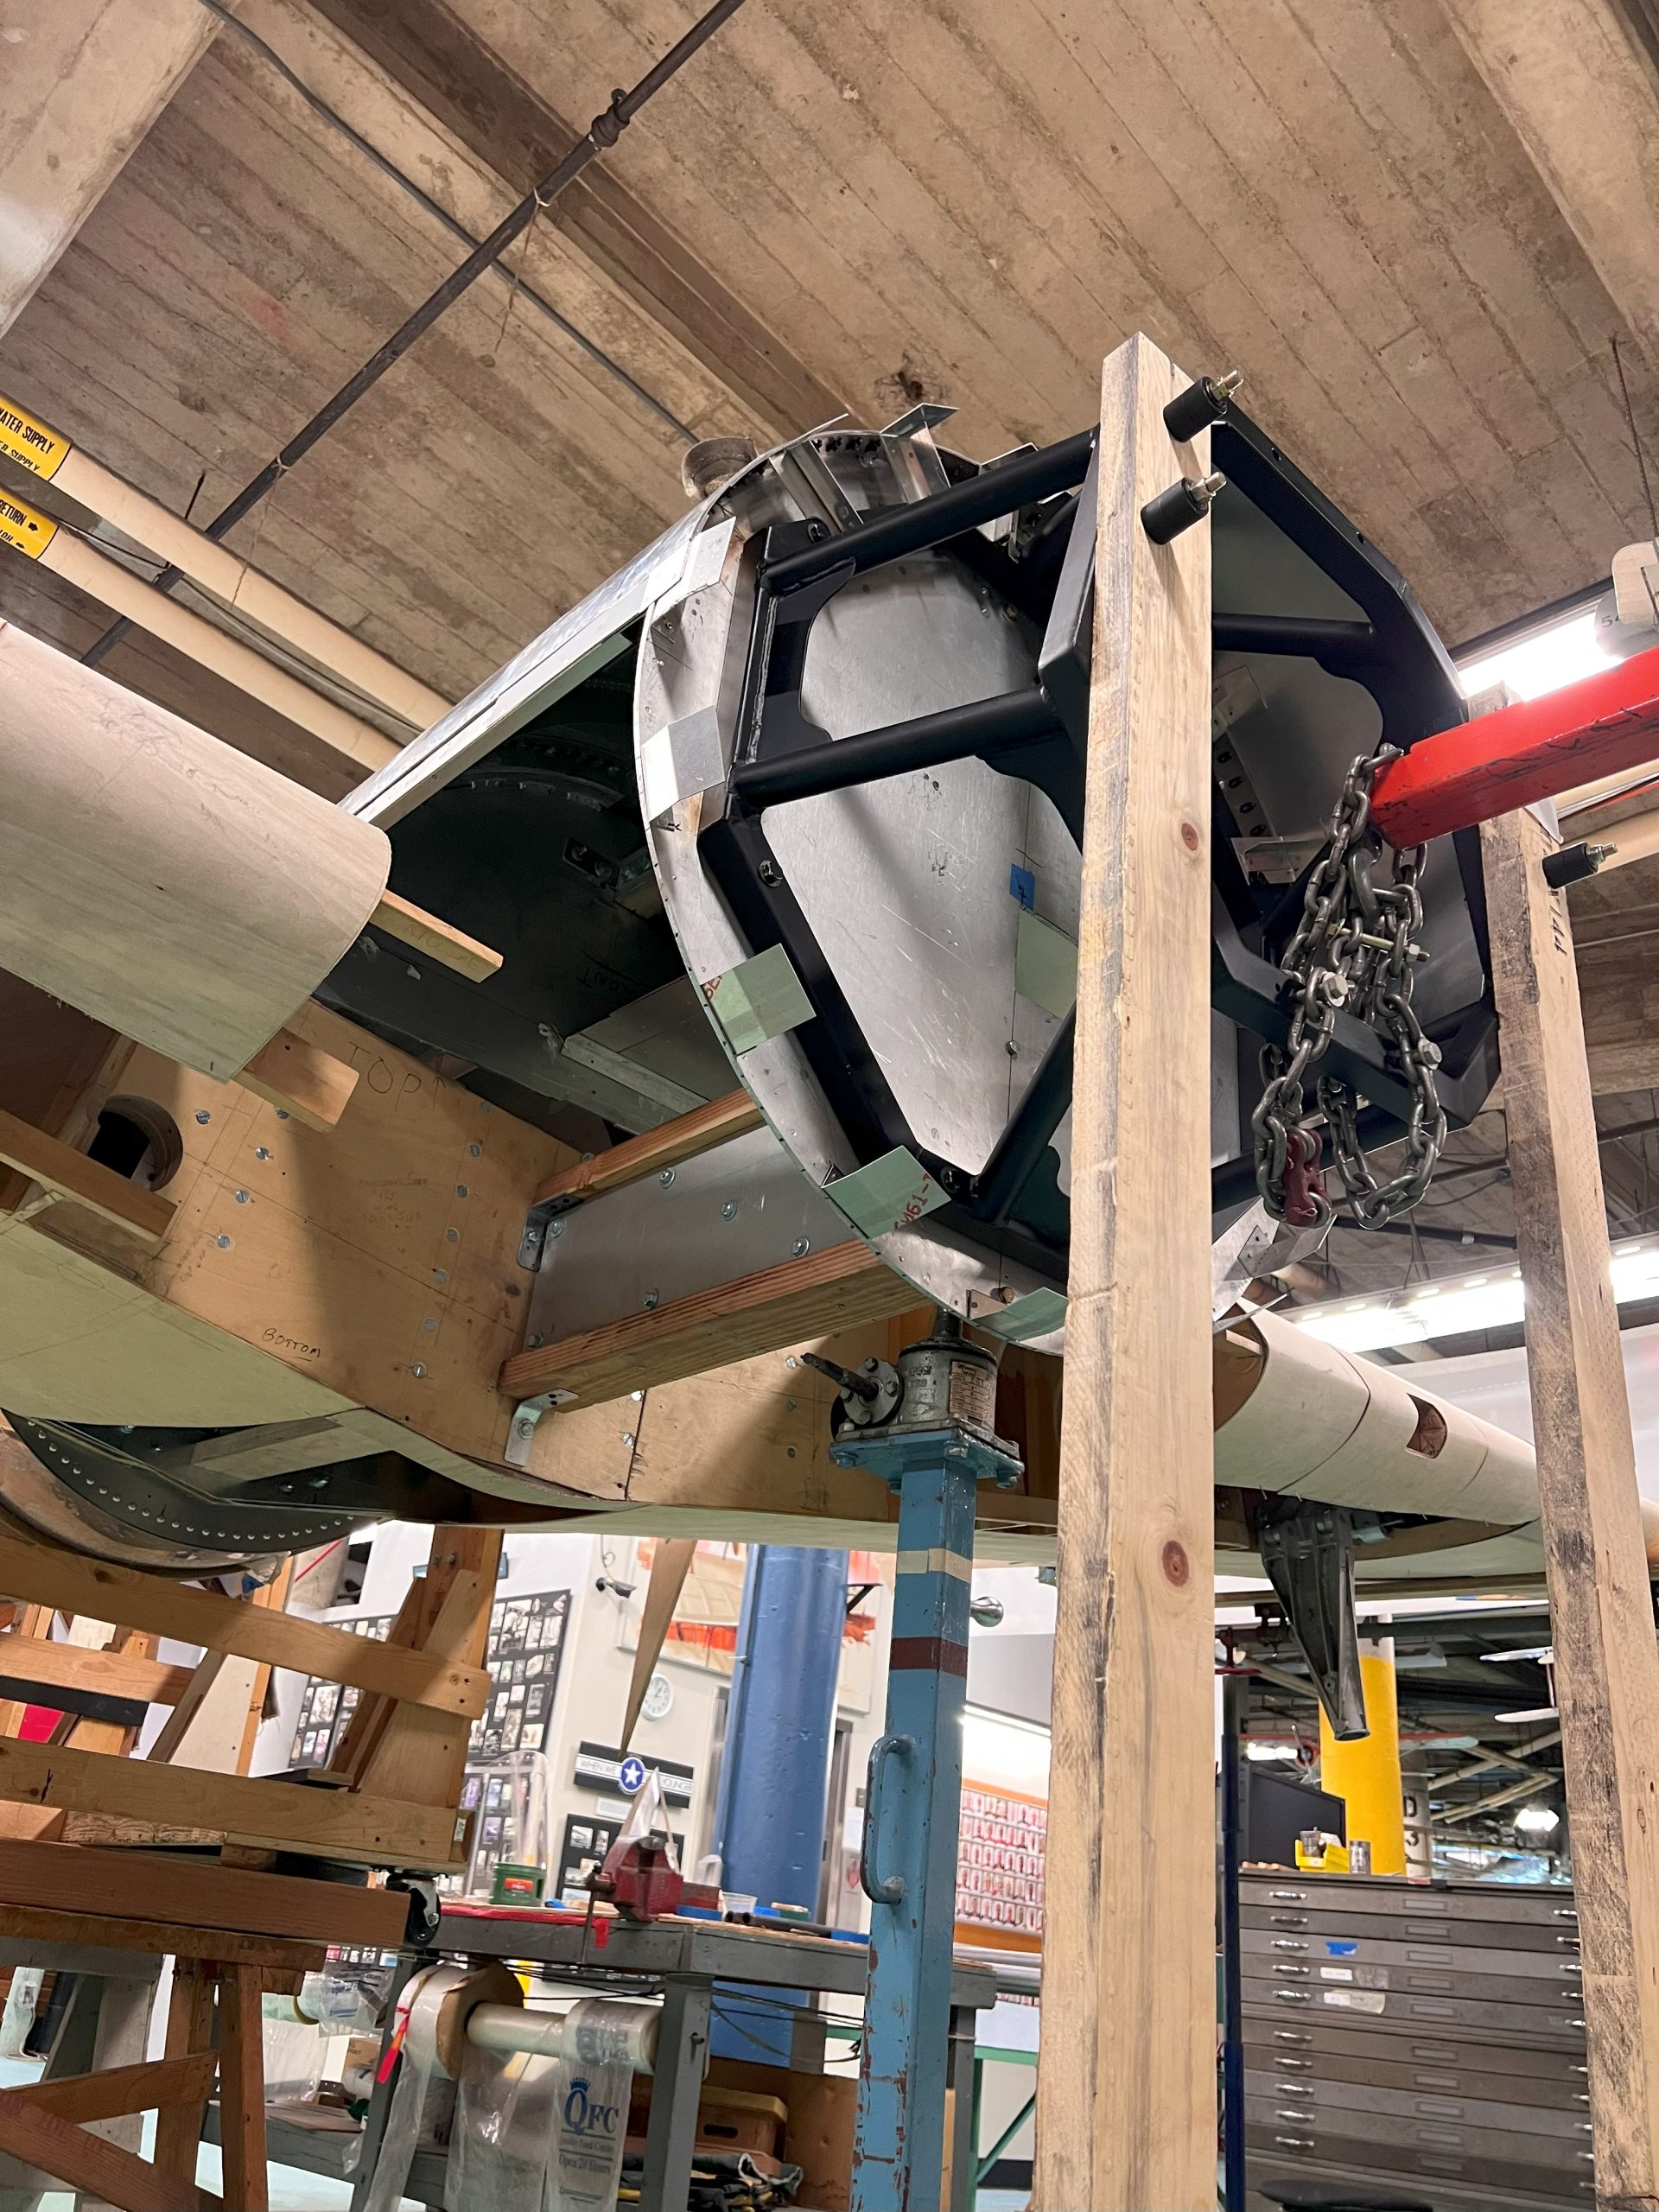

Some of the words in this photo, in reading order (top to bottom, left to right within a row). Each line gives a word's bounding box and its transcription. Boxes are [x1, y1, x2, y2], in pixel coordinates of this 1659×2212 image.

[22, 425, 55, 454] SUPPLY
[348, 1040, 422, 1111] TOP
[564, 2088, 619, 2136] QFC
